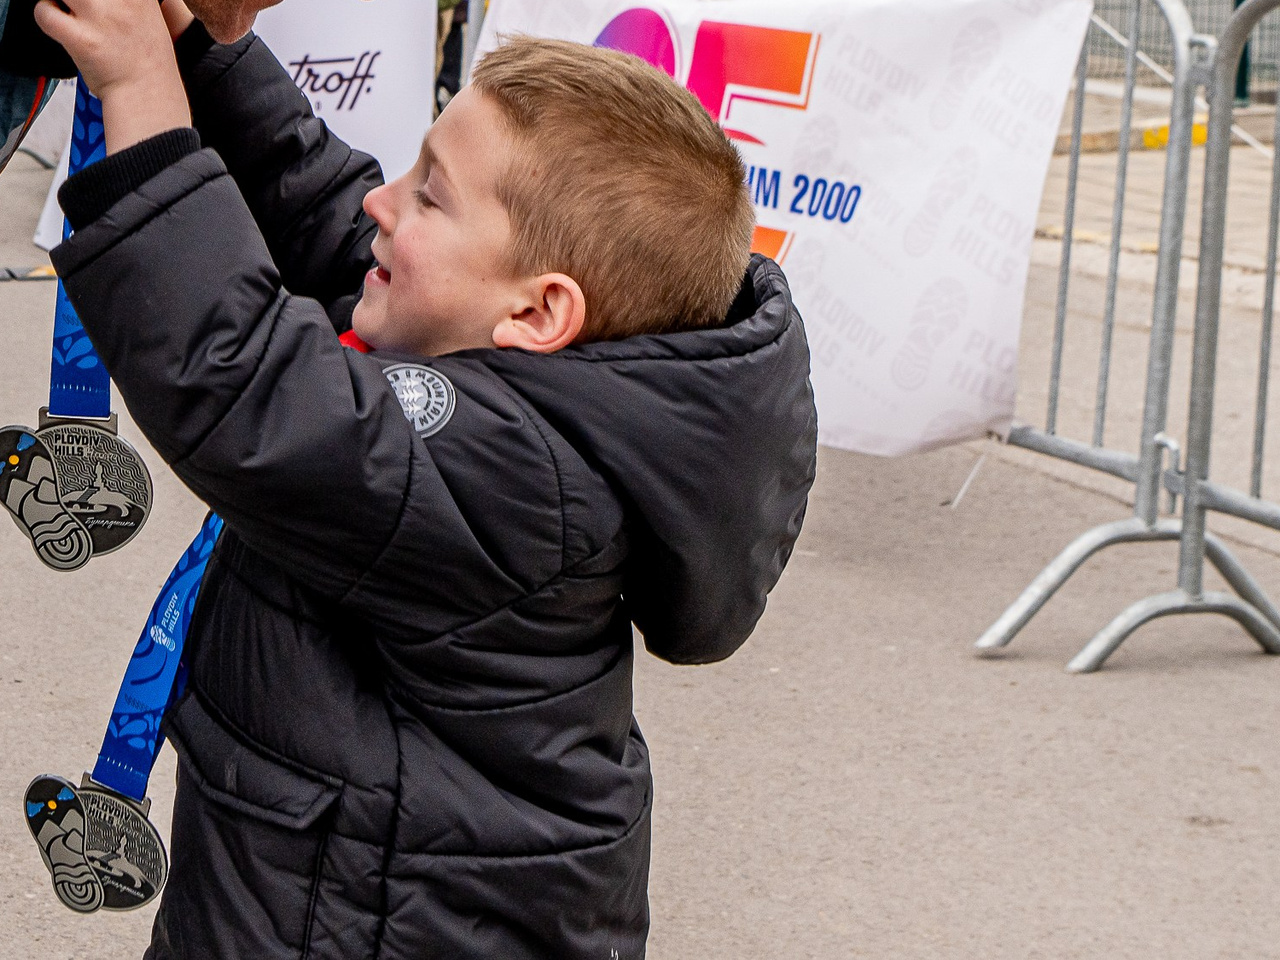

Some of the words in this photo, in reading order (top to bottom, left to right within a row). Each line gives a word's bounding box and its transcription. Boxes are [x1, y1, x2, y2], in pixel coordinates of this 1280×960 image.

[789, 173, 862, 224] 2000
[54, 434, 100, 446] PLOVDIV
[54, 445, 84, 457] HILLS
[161, 591, 179, 628] PLOVDIV
[168, 609, 180, 633] HILLS
[91, 796, 132, 821] PLOVDIV
